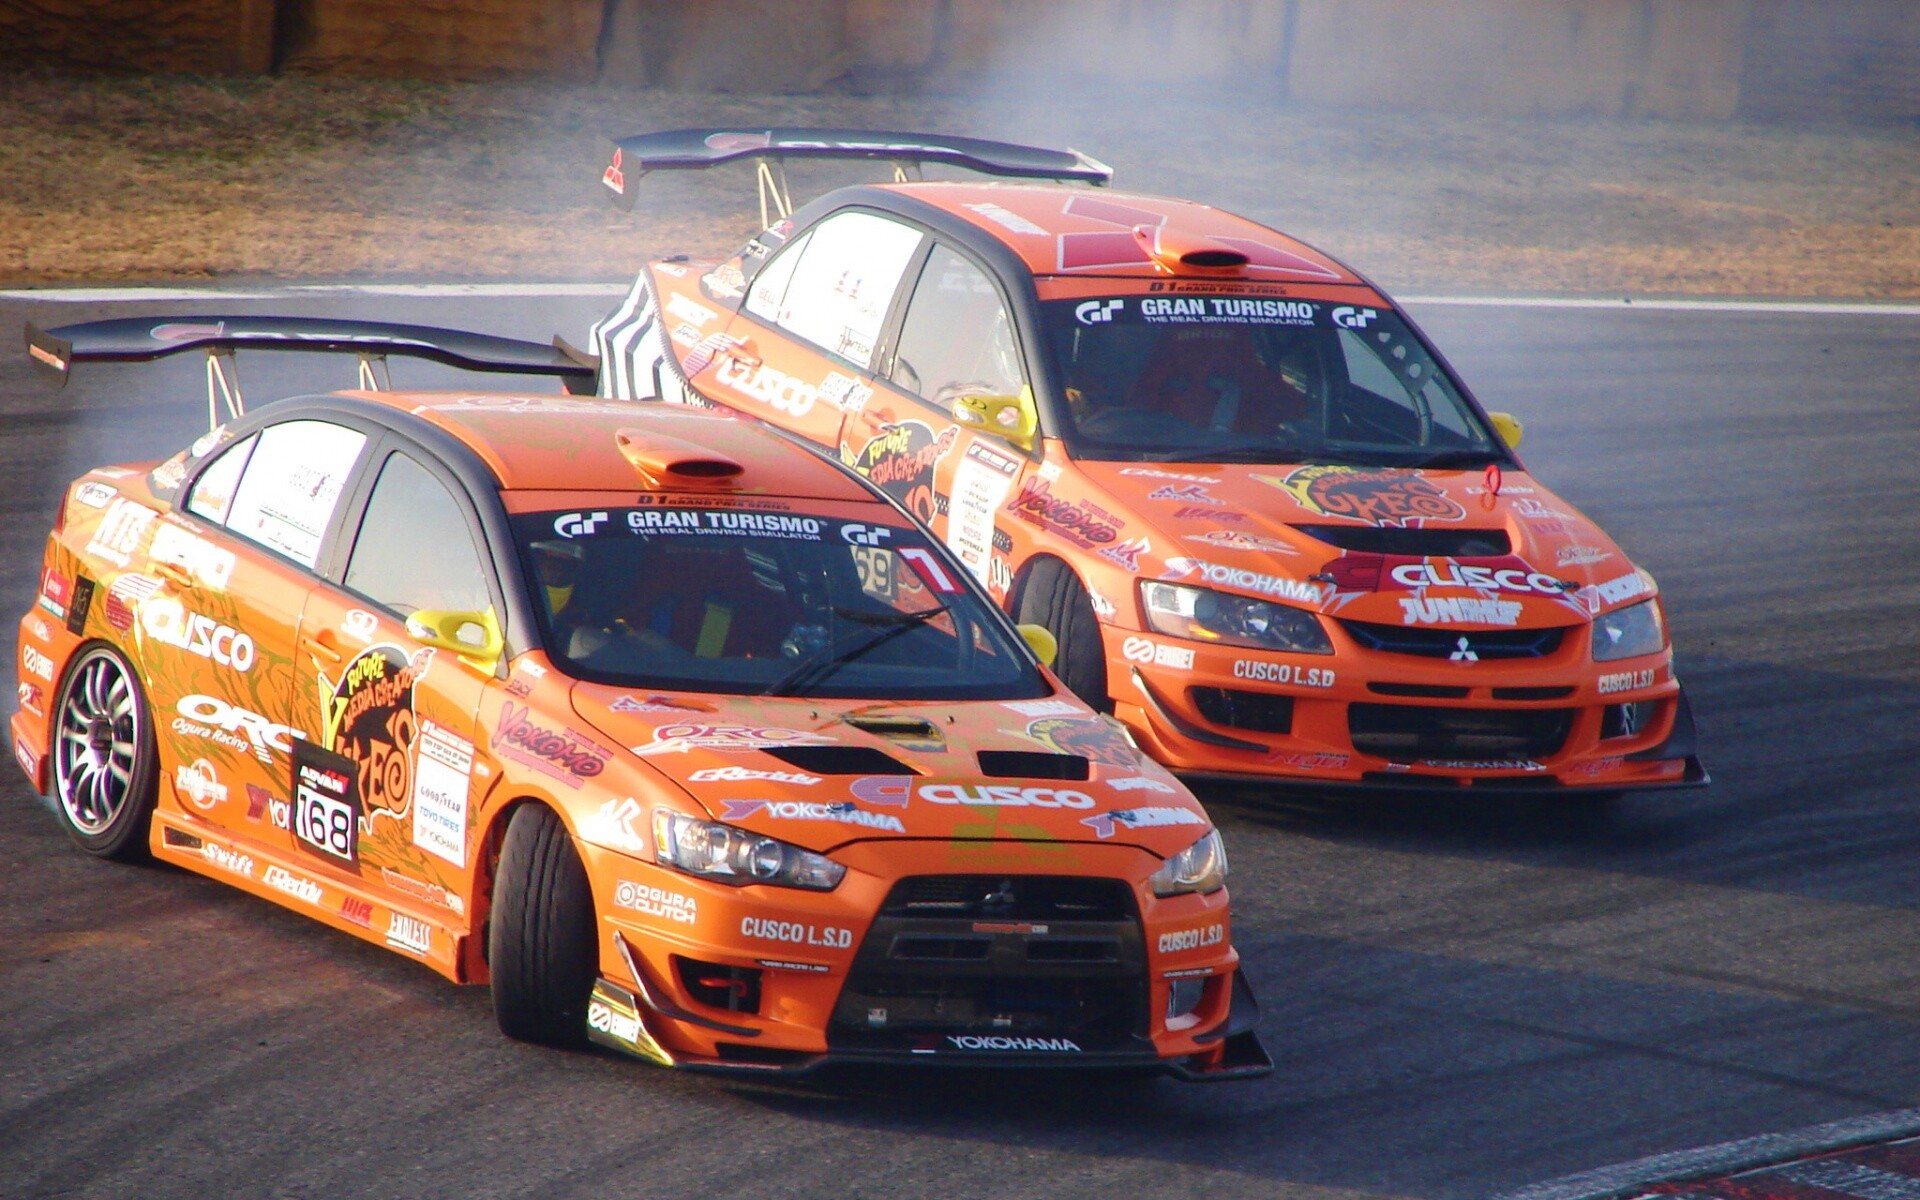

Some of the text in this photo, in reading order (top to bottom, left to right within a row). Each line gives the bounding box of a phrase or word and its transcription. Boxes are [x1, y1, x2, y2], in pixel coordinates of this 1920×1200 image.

[1141, 299, 1313, 319] GRAN TURISMO
[1170, 315, 1200, 323] REAL
[1202, 315, 1248, 324] DRIVING
[1250, 316, 1315, 326] SIMULATOR
[714, 357, 817, 418] CUSCO
[627, 511, 819, 535] GRAN TURISMO
[1007, 476, 1116, 543] YOKOMO
[660, 527, 693, 535] REAL
[695, 528, 747, 536] DRIVING
[749, 530, 821, 541] SIMULATOR
[1201, 562, 1324, 603] YOKOHAMA
[1391, 564, 1563, 594] CUSCO
[1234, 660, 1335, 687] CUSCO L.S.D
[1598, 672, 1632, 693] CUSCO
[171, 718, 249, 752] Ogura Racing
[176, 694, 308, 765] ORC
[491, 701, 605, 777] YOKOMO
[300, 765, 344, 794] ADVAN
[918, 784, 1096, 810] CUSCO
[299, 792, 349, 856] 168
[765, 800, 906, 833] YOKOHAMA
[203, 842, 254, 875] Swift
[634, 899, 696, 924] CLUTCH
[636, 884, 697, 910] OGURA
[741, 917, 853, 949] CUSCO L.S.D
[1158, 929, 1199, 953] CUSCO
[946, 1036, 1082, 1052] YOKOHAMA
